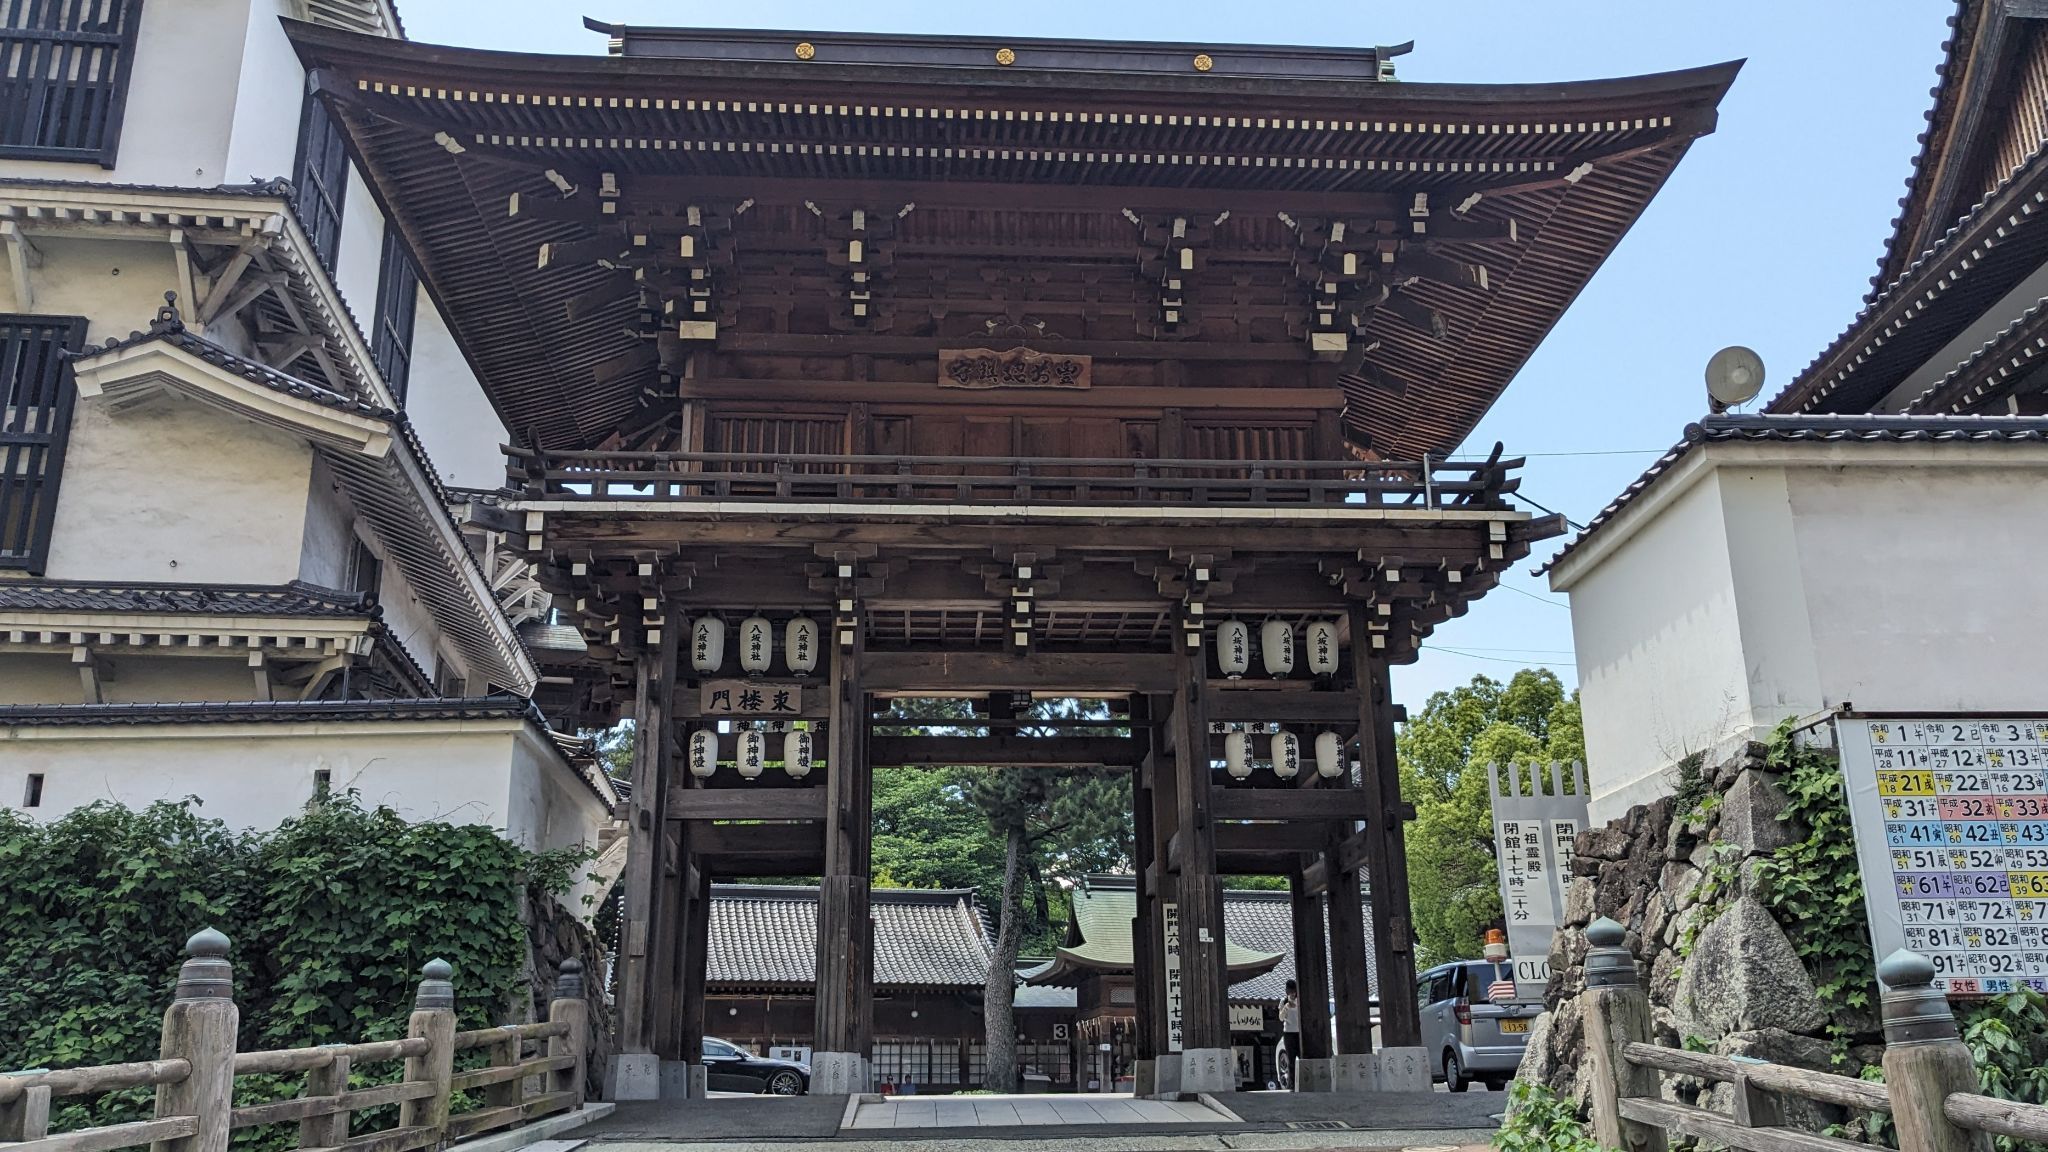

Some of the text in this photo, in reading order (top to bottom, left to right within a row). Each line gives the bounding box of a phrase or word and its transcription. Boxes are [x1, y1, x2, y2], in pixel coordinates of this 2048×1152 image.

[696, 625, 709, 661] 八坂神社
[750, 625, 762, 661] 八坂神社
[797, 625, 809, 661] 八坂神社
[1232, 628, 1243, 664] 八坂神社
[1282, 628, 1291, 664] 八坂神社
[1317, 628, 1328, 664] 八坂神社
[1871, 724, 1889, 733] 令和
[1898, 725, 1906, 742] 1
[1878, 735, 1884, 743] 8
[1926, 724, 1944, 733] 令和
[1952, 725, 1965, 741] 2
[1934, 735, 1940, 743] 7
[1982, 724, 1999, 733] 令和
[2007, 725, 2019, 741] 3
[1875, 750, 1893, 758] 平成
[1897, 750, 1917, 766] 11
[1880, 760, 1892, 768] 28
[1931, 750, 1949, 758] 平成
[1952, 750, 1974, 766] 12
[1936, 760, 1947, 768] 27
[1986, 750, 2004, 758] 平成
[2007, 750, 2028, 766] 13
[1991, 760, 2003, 768] 26
[1879, 774, 1898, 782] 平成
[1901, 775, 1921, 791] 21
[1885, 785, 1896, 793] 18
[1935, 774, 1953, 782] 平成
[1956, 775, 1979, 790] 22
[1991, 774, 2009, 782] 平成
[2013, 775, 2035, 790] 23
[1884, 800, 1902, 808] 平成
[1905, 800, 1925, 816] 31
[1891, 810, 1897, 818] 8
[1940, 800, 1958, 808] 平成
[1961, 800, 1984, 816] 32
[1947, 810, 1953, 818] 7
[1996, 800, 2014, 808] 平成
[2018, 800, 2039, 816] 33
[2004, 809, 2011, 817] 6
[1888, 825, 1906, 833] 昭和
[1910, 825, 1929, 841] 41
[1944, 825, 1962, 833] 昭和
[1966, 825, 1989, 841] 42
[1950, 835, 1961, 843] 60
[2000, 824, 2044, 841] 昭和 43
[2006, 835, 2017, 843] 59
[1893, 850, 1911, 858] 昭和
[1915, 851, 1934, 867] 51
[1898, 861, 1909, 870] 51
[1950, 850, 1967, 858] 昭和
[1971, 851, 1994, 867] 52
[1954, 861, 1966, 869] 50
[2027, 851, 2048, 867] 53
[1897, 876, 1915, 884] 昭和
[1919, 877, 1939, 893] 61
[1954, 875, 1972, 884] 昭和
[1975, 877, 1999, 893] 62
[2010, 875, 2028, 884] 昭和
[1902, 887, 1913, 895] 41
[1959, 887, 1971, 895] 40
[2016, 887, 2027, 895] 39
[1902, 902, 1920, 911] 昭和
[1922, 903, 1944, 919] 71
[1907, 913, 1918, 922] 31
[1958, 902, 1977, 910] 昭和
[1979, 903, 2004, 919] 72
[1964, 913, 1976, 921] 30
[2015, 901, 2048, 919] 昭和 7
[2021, 912, 2032, 920] 29
[1906, 928, 1925, 937] 昭和
[1928, 929, 1949, 946] 81
[1963, 927, 1982, 936] 昭和
[1985, 929, 2009, 945] 82
[1969, 939, 1981, 947] 20
[2020, 927, 2048, 945] 昭和 8
[2026, 939, 2037, 947] 19
[1912, 940, 1923, 949] 21
[1933, 955, 1954, 973] 91
[1969, 954, 1987, 963] 昭和
[1990, 955, 2014, 972] 92
[2025, 953, 2043, 962] 昭和
[1974, 966, 1986, 974] 10
[2034, 965, 2039, 973] 9
[1952, 981, 1976, 991] 女性
[1987, 979, 2010, 990] 男性
[1056, 1025, 1066, 1038] 3
